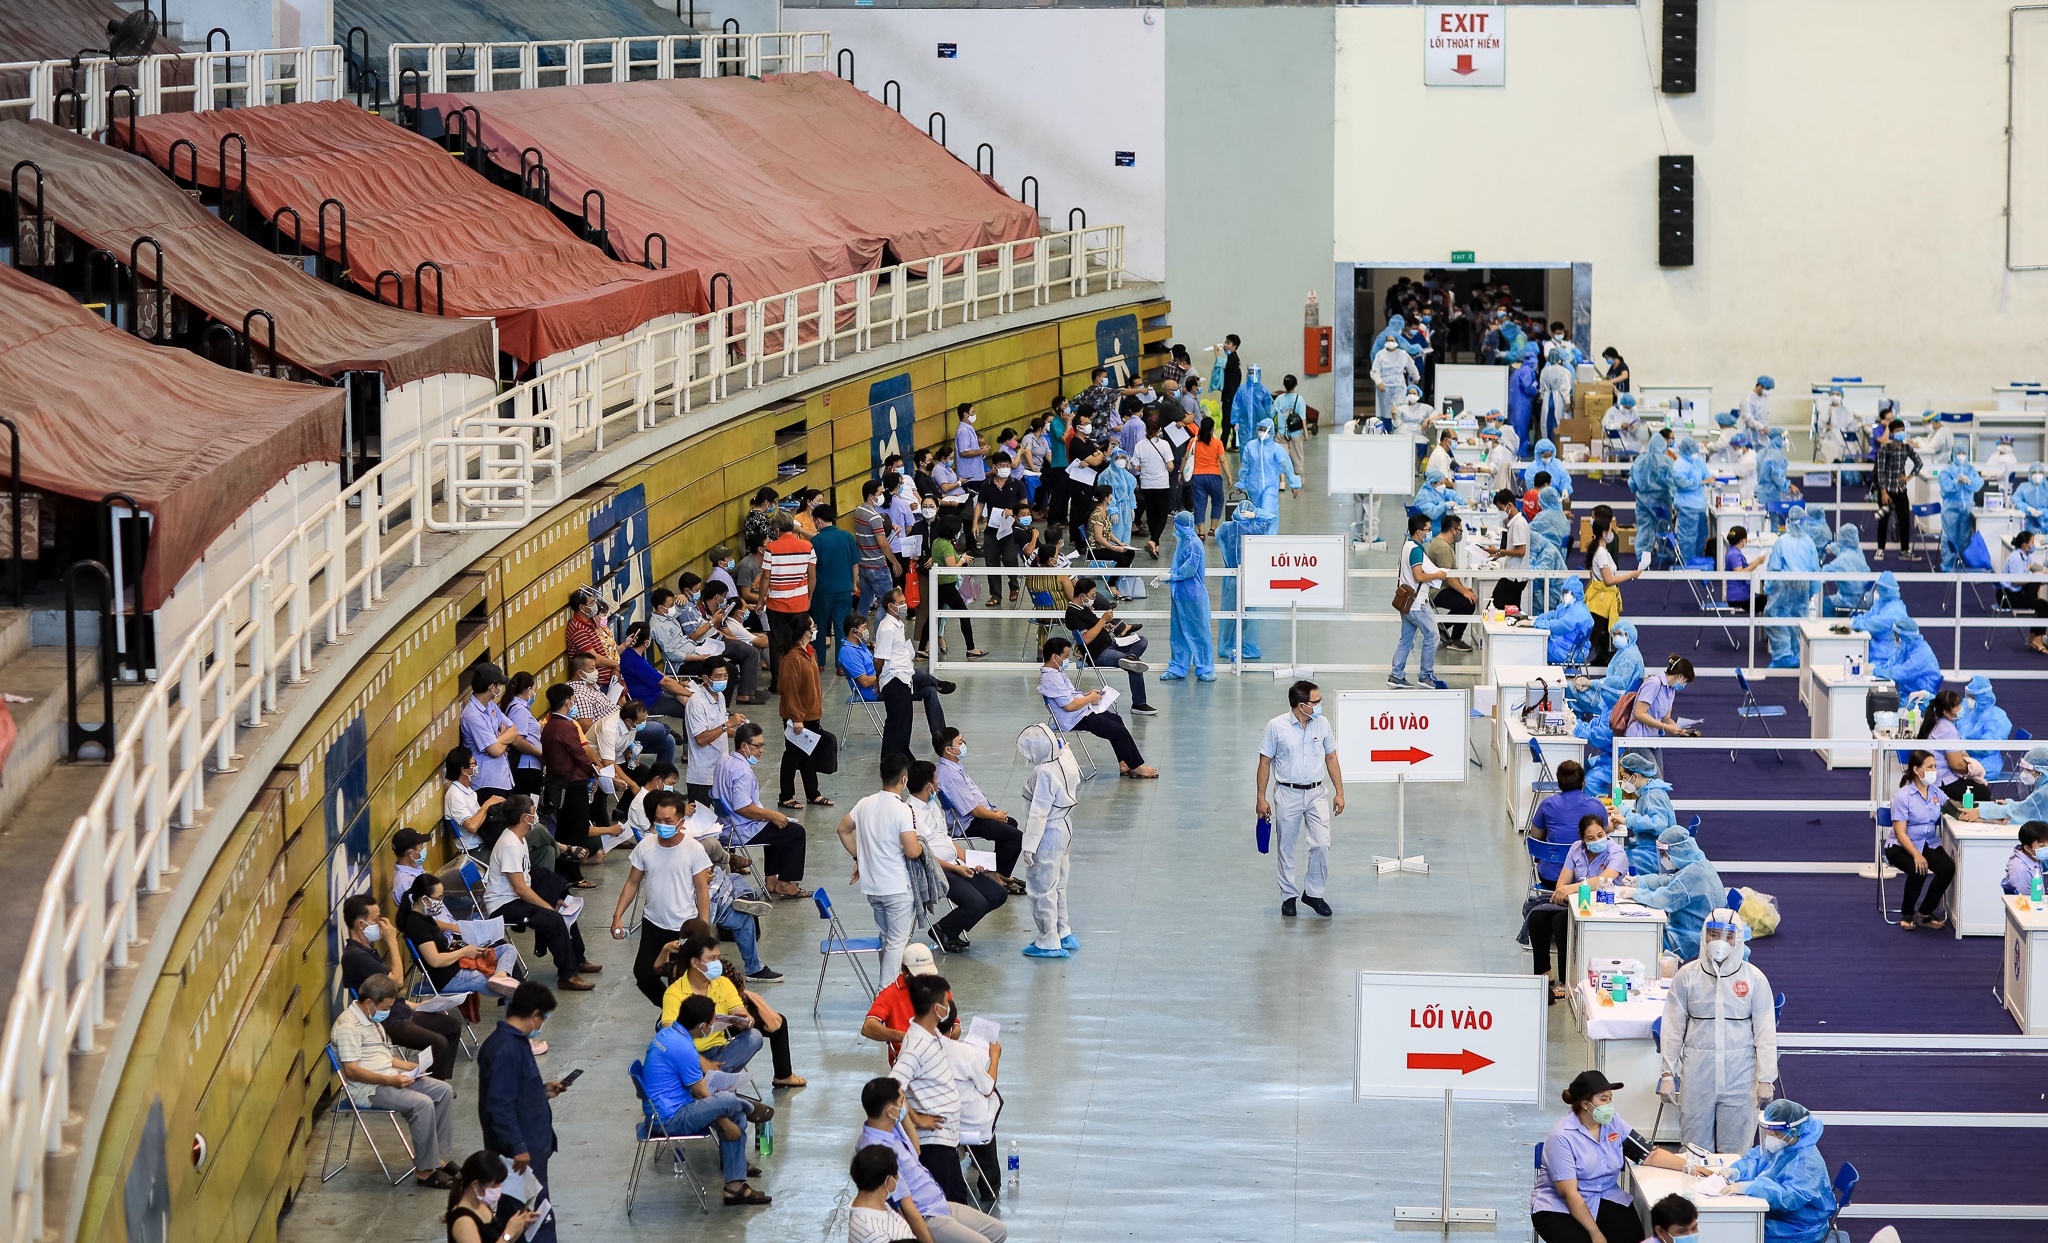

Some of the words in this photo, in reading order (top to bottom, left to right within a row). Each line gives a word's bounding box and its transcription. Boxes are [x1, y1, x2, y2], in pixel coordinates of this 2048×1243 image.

[1441, 13, 1489, 33] EXIT
[1447, 35, 1475, 48] THOÁT
[1477, 33, 1500, 49] HIỂM
[1271, 552, 1290, 567] LỐI
[1294, 552, 1317, 567] VÀO
[1370, 711, 1394, 730] LỐI
[1399, 712, 1429, 730] VÀO
[1410, 1003, 1444, 1029] LỐI
[1451, 1005, 1493, 1031] VÀO
